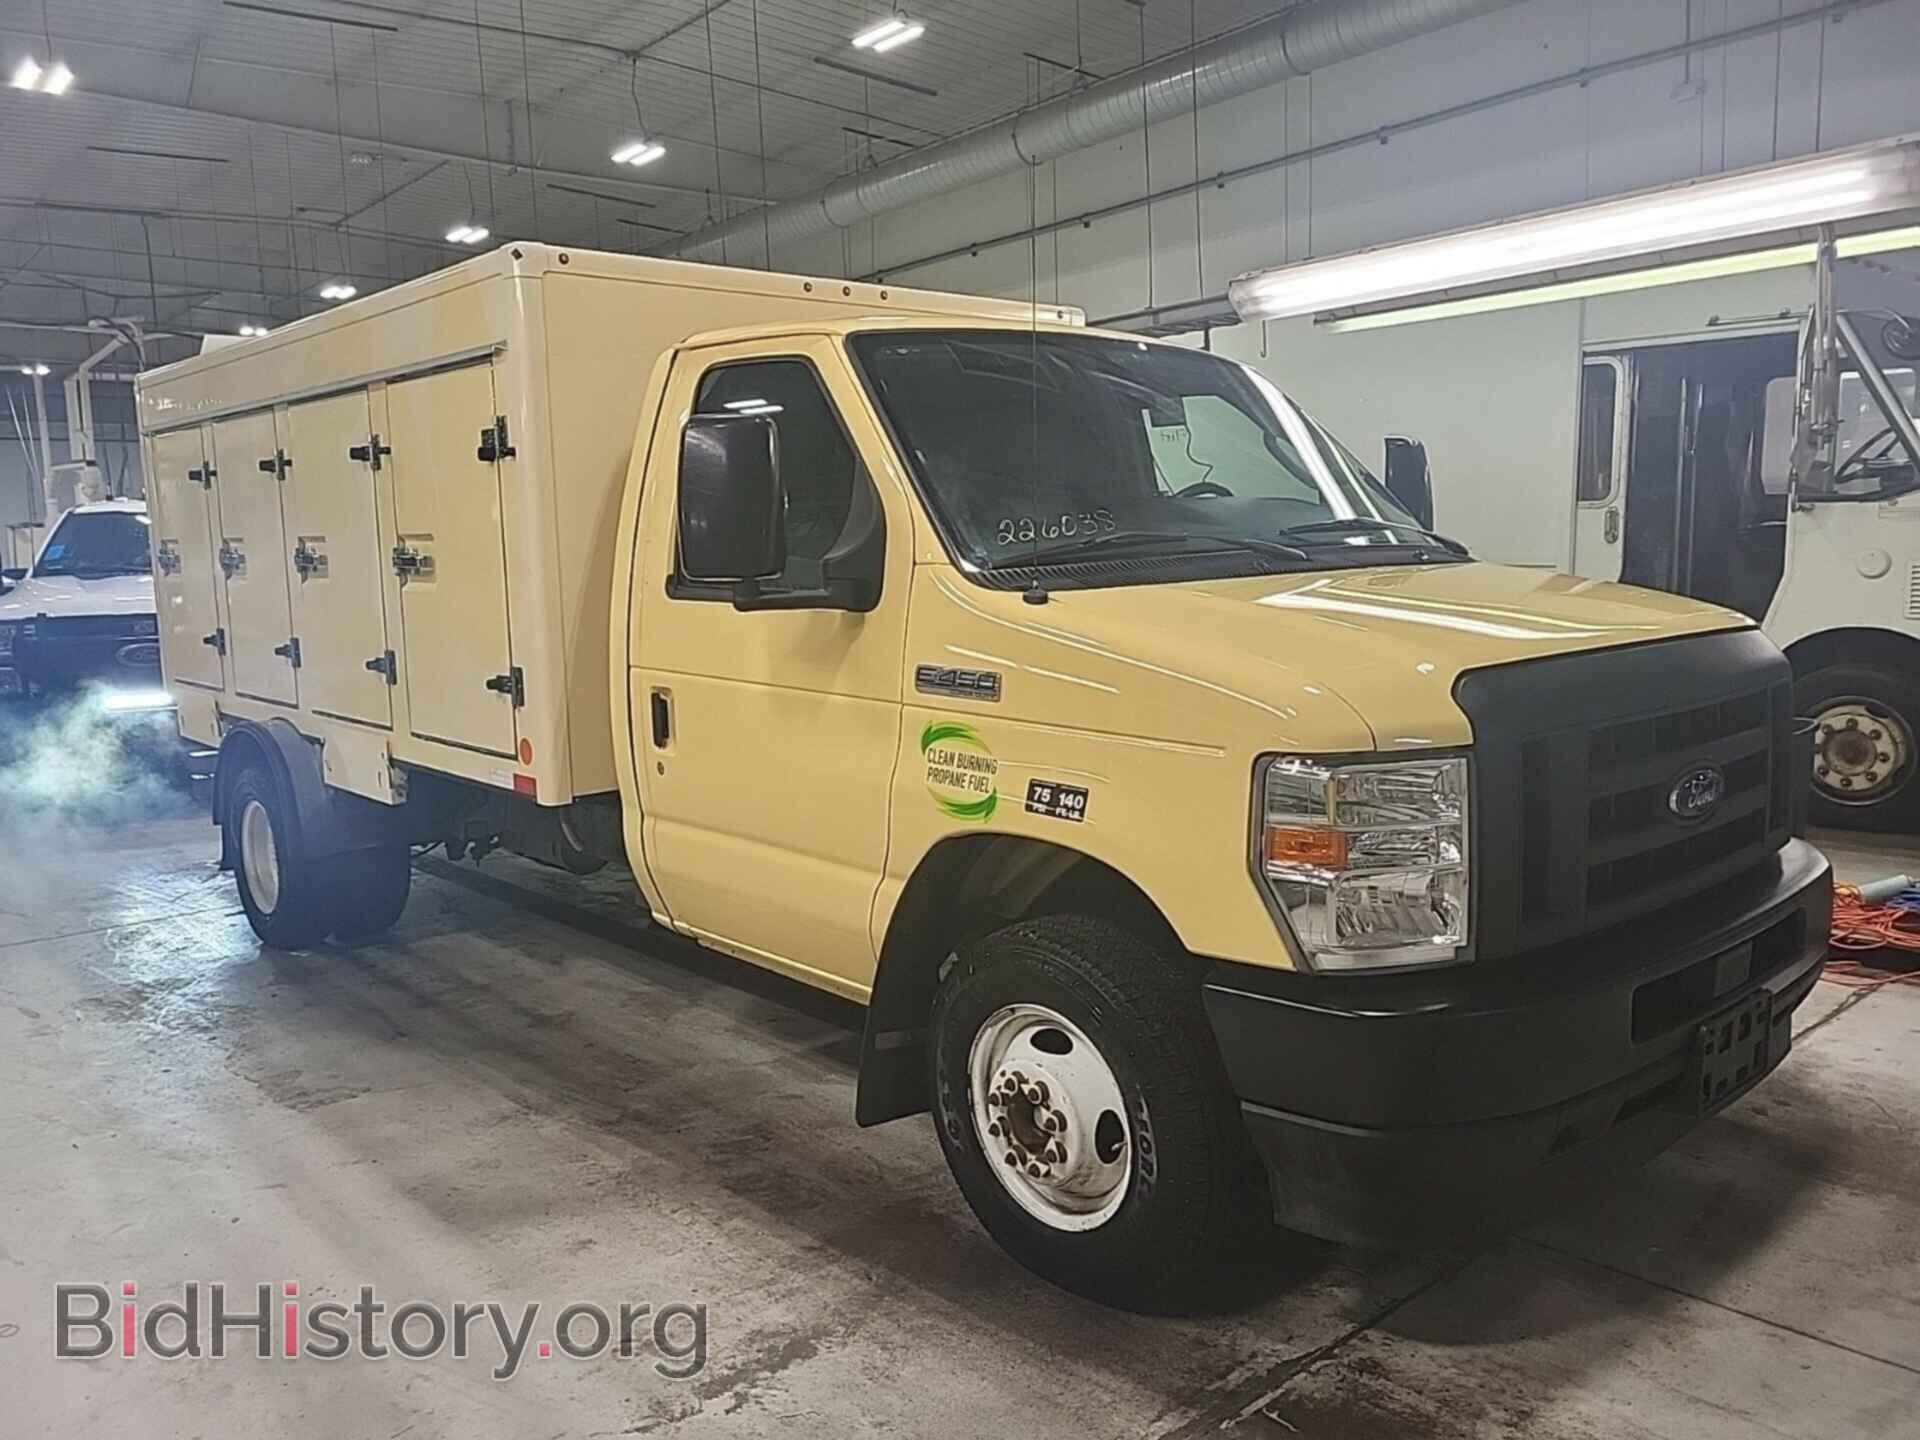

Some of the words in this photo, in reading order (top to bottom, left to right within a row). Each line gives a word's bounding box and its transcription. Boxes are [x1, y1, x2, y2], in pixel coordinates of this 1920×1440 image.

[927, 748, 954, 765] CLEAN
[956, 752, 998, 774] BURNING
[927, 767, 966, 789] PROPANE
[968, 775, 990, 794] FUEL
[1033, 786, 1051, 803] 75
[1058, 792, 1084, 809] 140
